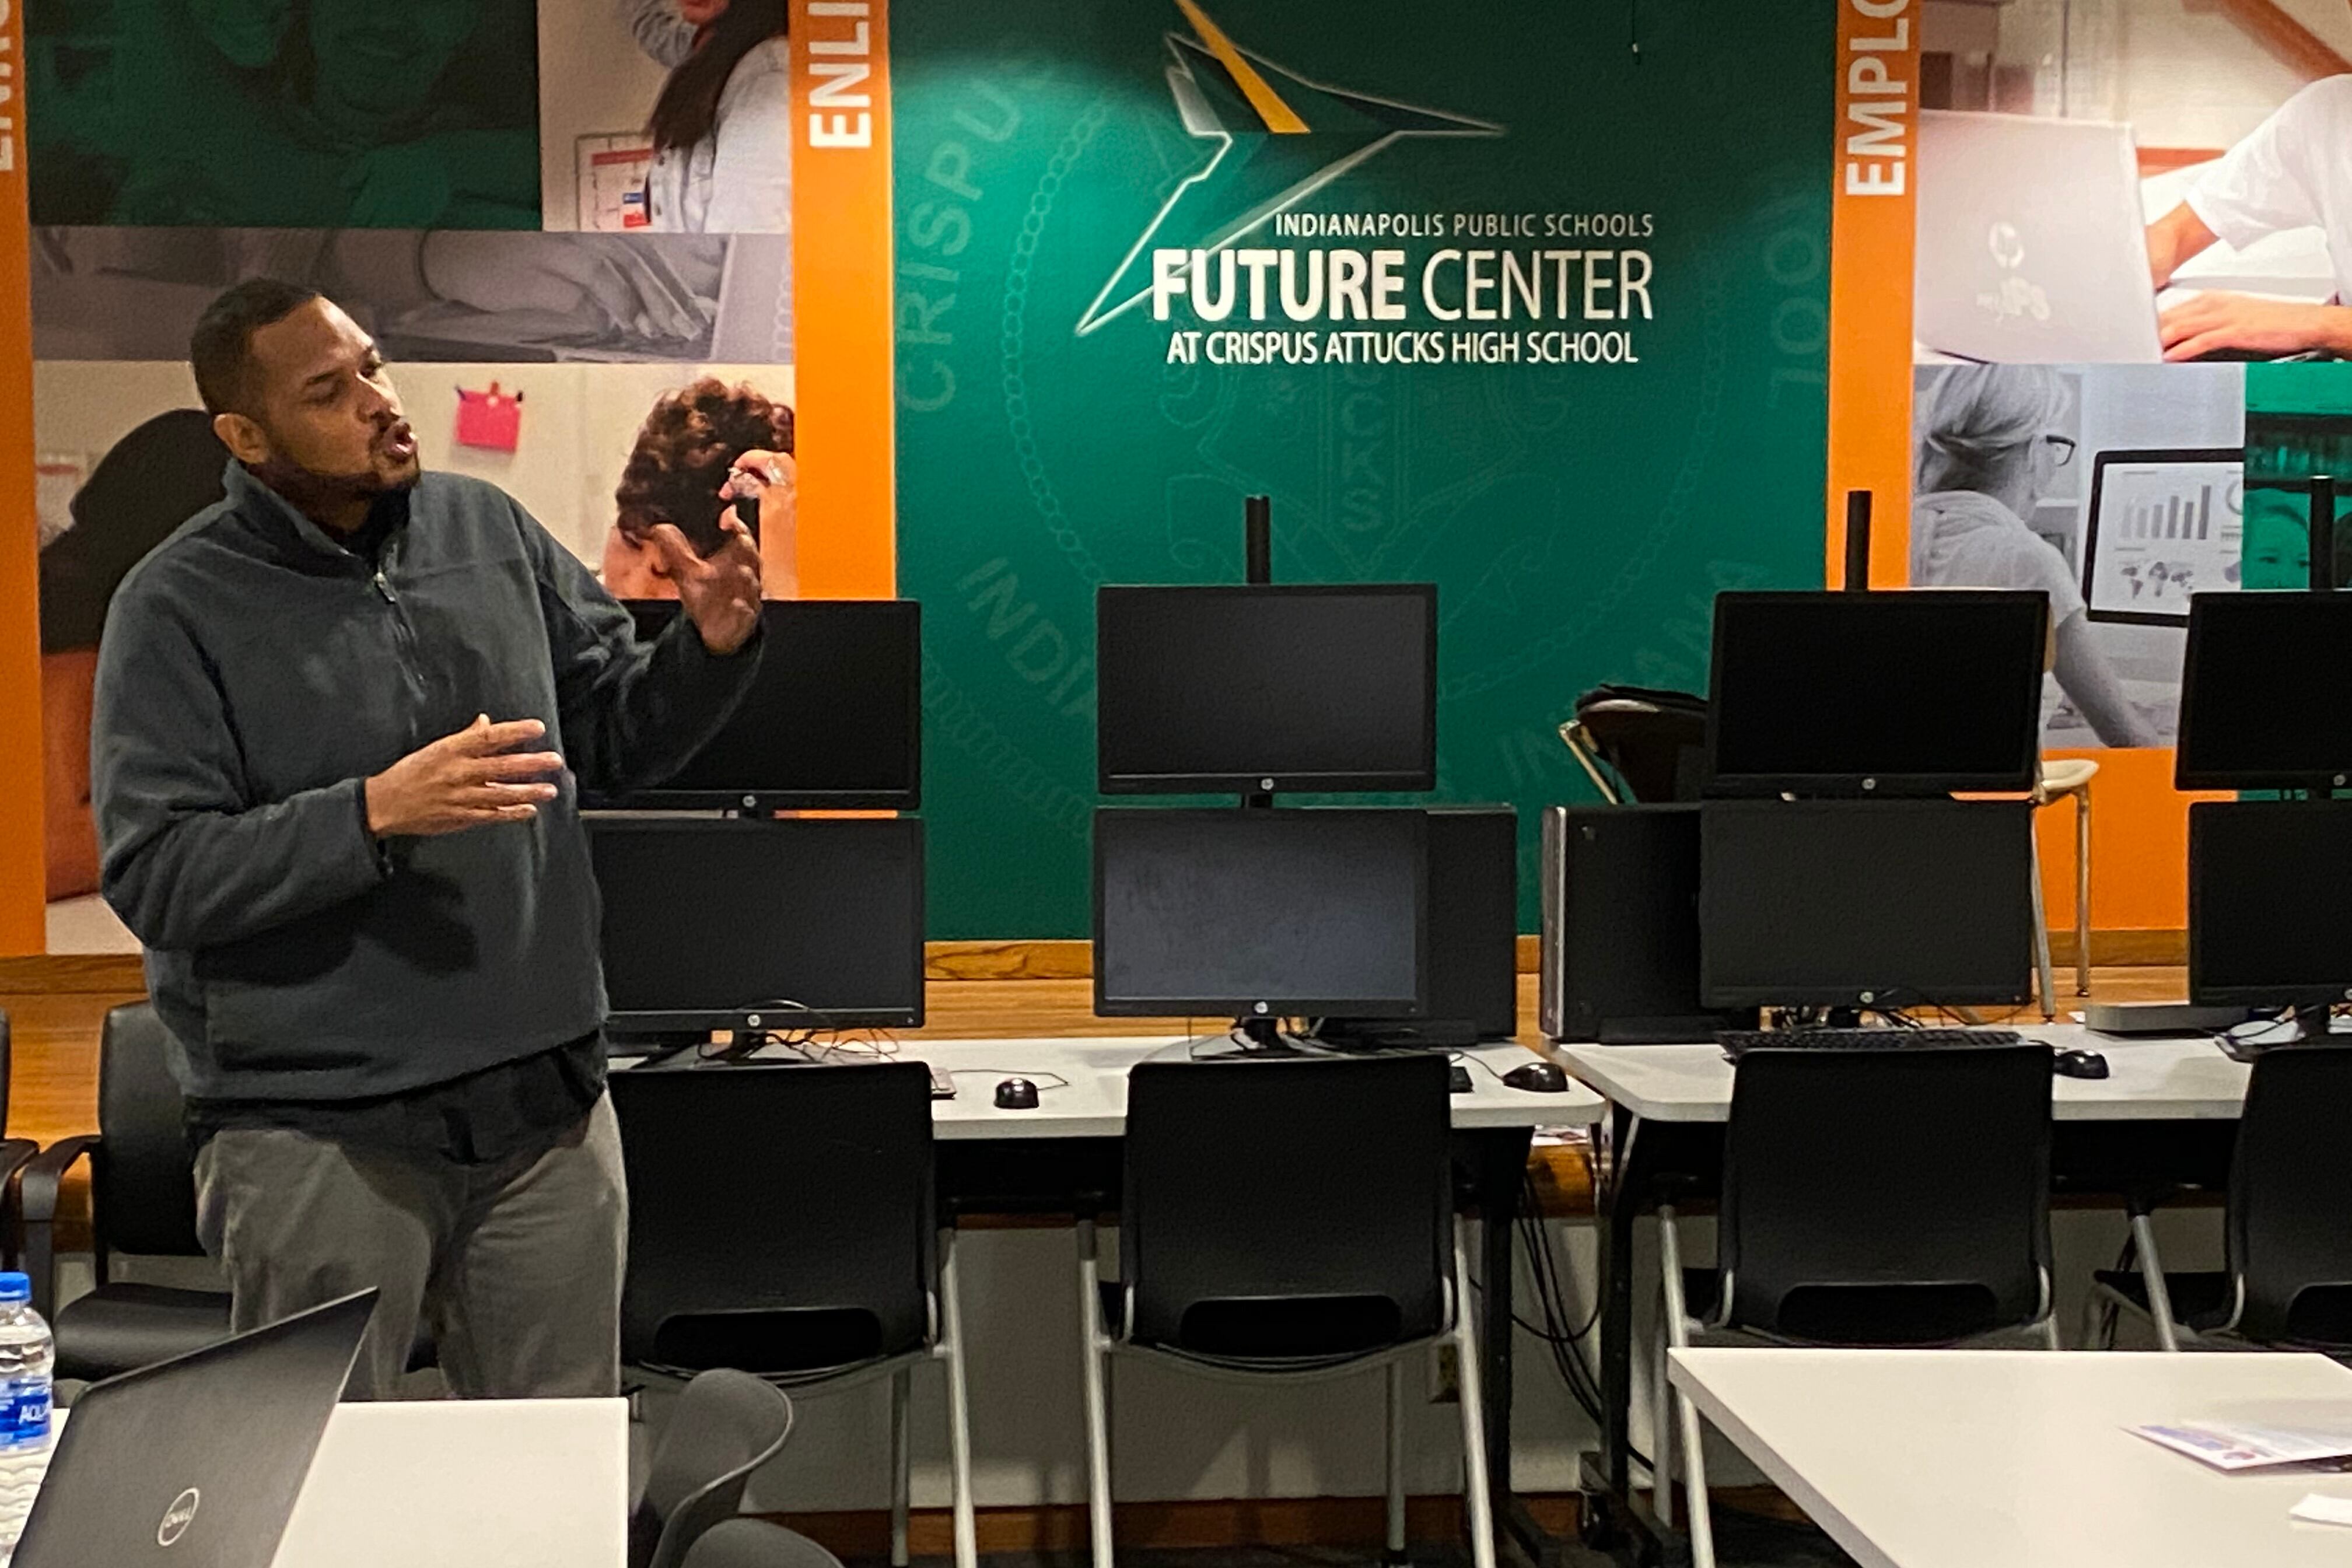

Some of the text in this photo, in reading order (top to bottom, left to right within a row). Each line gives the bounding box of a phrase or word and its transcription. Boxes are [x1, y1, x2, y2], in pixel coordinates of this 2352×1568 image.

[898, 73, 1030, 412] CRISPU
[1276, 214, 1654, 236] INDIANAPOLIS PUBLIC SCHOOLS
[1153, 249, 1653, 321] FUTURE CENTER
[1167, 331, 1639, 365] AT CRISPUS ATTUCKS HIGH SCHOOL
